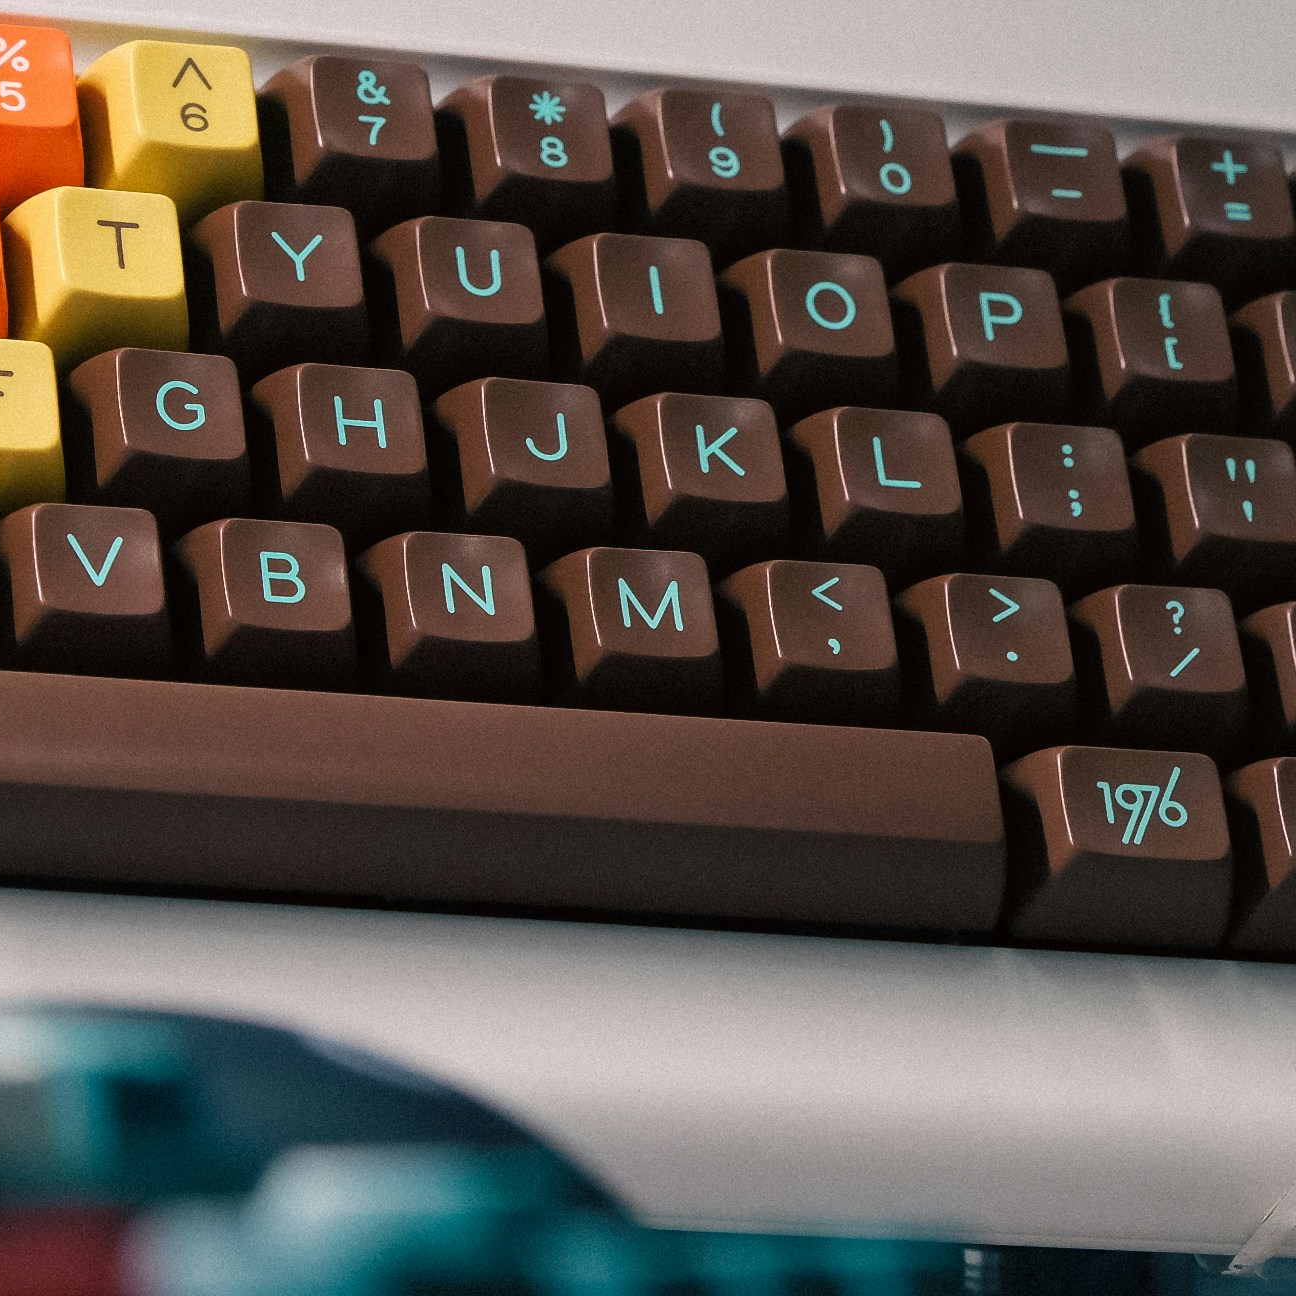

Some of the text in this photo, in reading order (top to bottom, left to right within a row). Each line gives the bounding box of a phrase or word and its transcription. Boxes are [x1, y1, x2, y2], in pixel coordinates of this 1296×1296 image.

[356, 69, 391, 105] &
[179, 101, 210, 133] 6
[358, 114, 386, 146] 7
[710, 102, 725, 137] (
[879, 119, 894, 153] )
[540, 136, 569, 168] 8
[708, 146, 741, 179] 9
[1212, 151, 1247, 185] +
[97, 220, 139, 268] T
[272, 232, 323, 281] Y
[456, 247, 501, 296] U
[650, 266, 663, 314] I
[806, 282, 856, 330] O
[980, 292, 1022, 340] P
[156, 381, 206, 431] G
[334, 397, 387, 448] H
[526, 413, 568, 461] J
[696, 425, 745, 476] K
[873, 438, 921, 488] L
[68, 534, 123, 586] V
[260, 551, 306, 603] B
[442, 564, 495, 615] N
[619, 579, 684, 631] M
[811, 576, 844, 612] <
[989, 588, 1021, 623] >
[1165, 599, 1186, 635] ?
[1169, 647, 1200, 678] /
[1097, 767, 1188, 845] 1976
